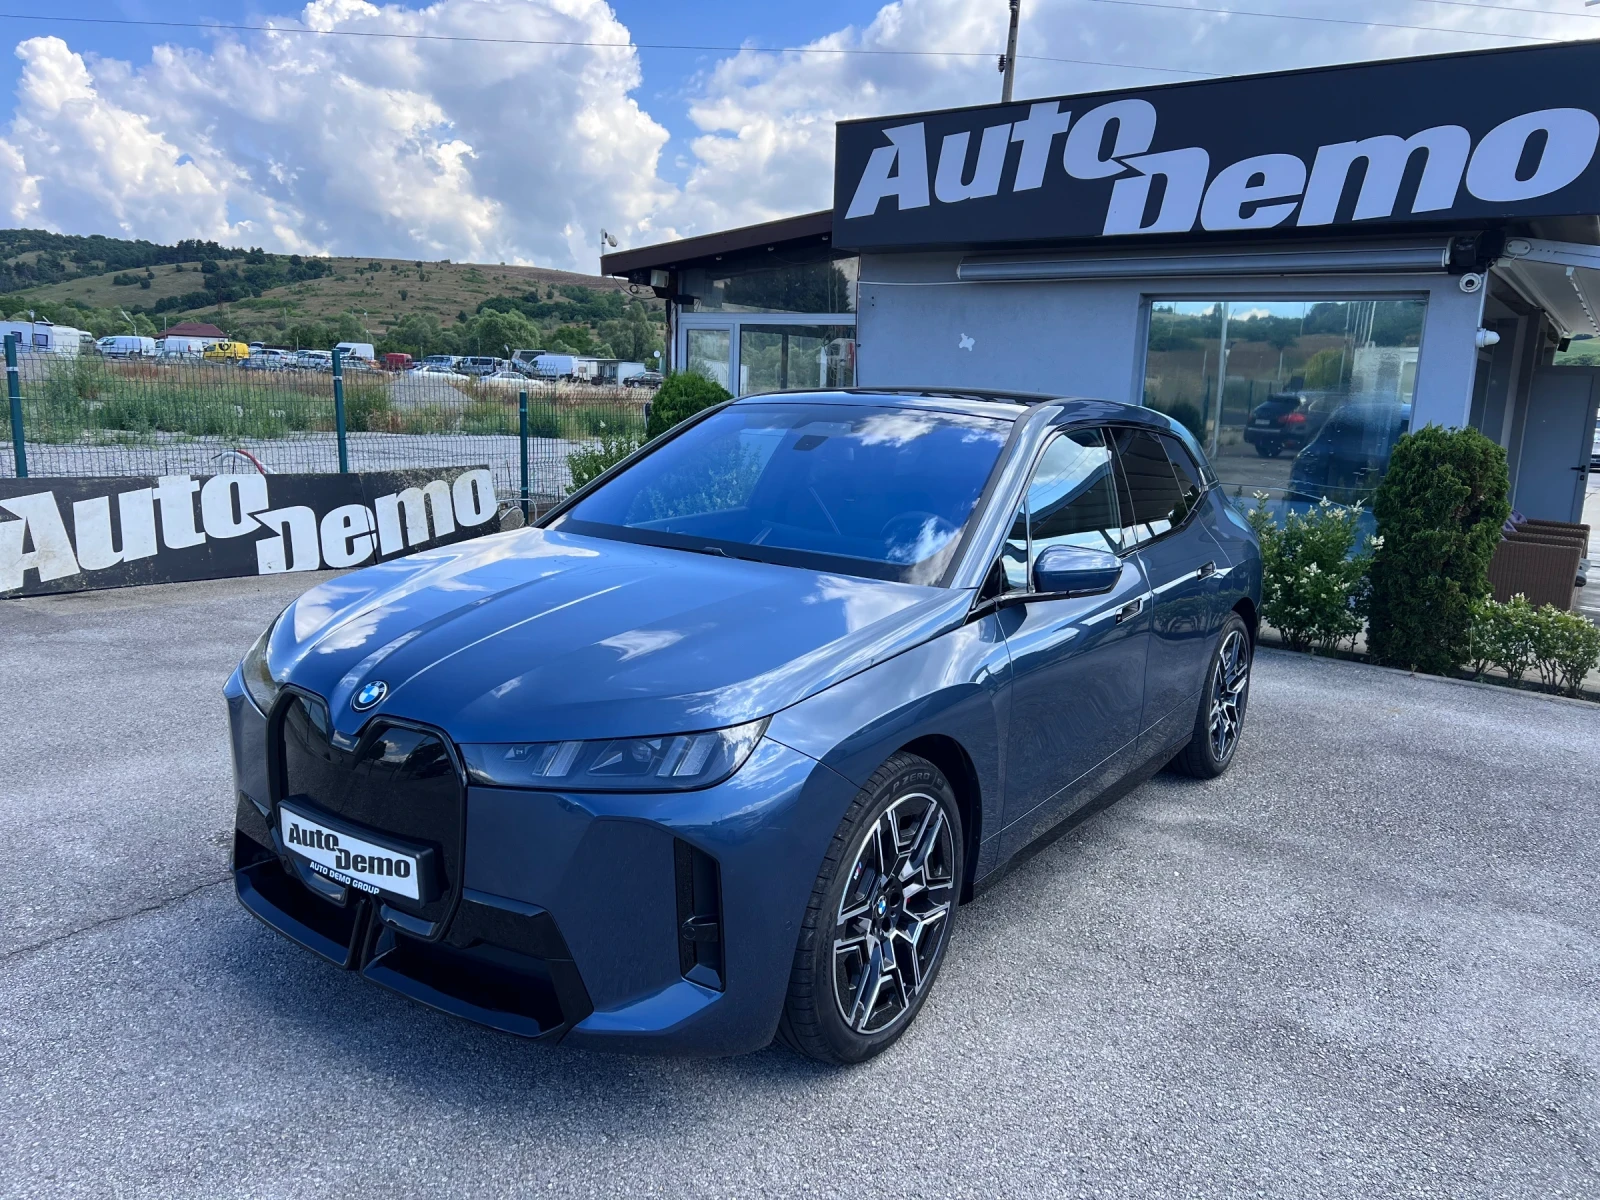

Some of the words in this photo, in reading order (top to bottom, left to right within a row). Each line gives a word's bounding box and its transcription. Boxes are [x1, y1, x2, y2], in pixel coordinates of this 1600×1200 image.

[844, 98, 1158, 220] Auto
[1102, 106, 1599, 236] Demo
[0, 473, 272, 594] Auto
[254, 468, 499, 575] Demo
[902, 772, 931, 786] ZERO
[288, 822, 339, 852] Auto
[335, 847, 411, 879] Demo
[309, 861, 328, 876] AUTO
[329, 870, 351, 885] DEMO
[352, 879, 380, 895] GROUP
